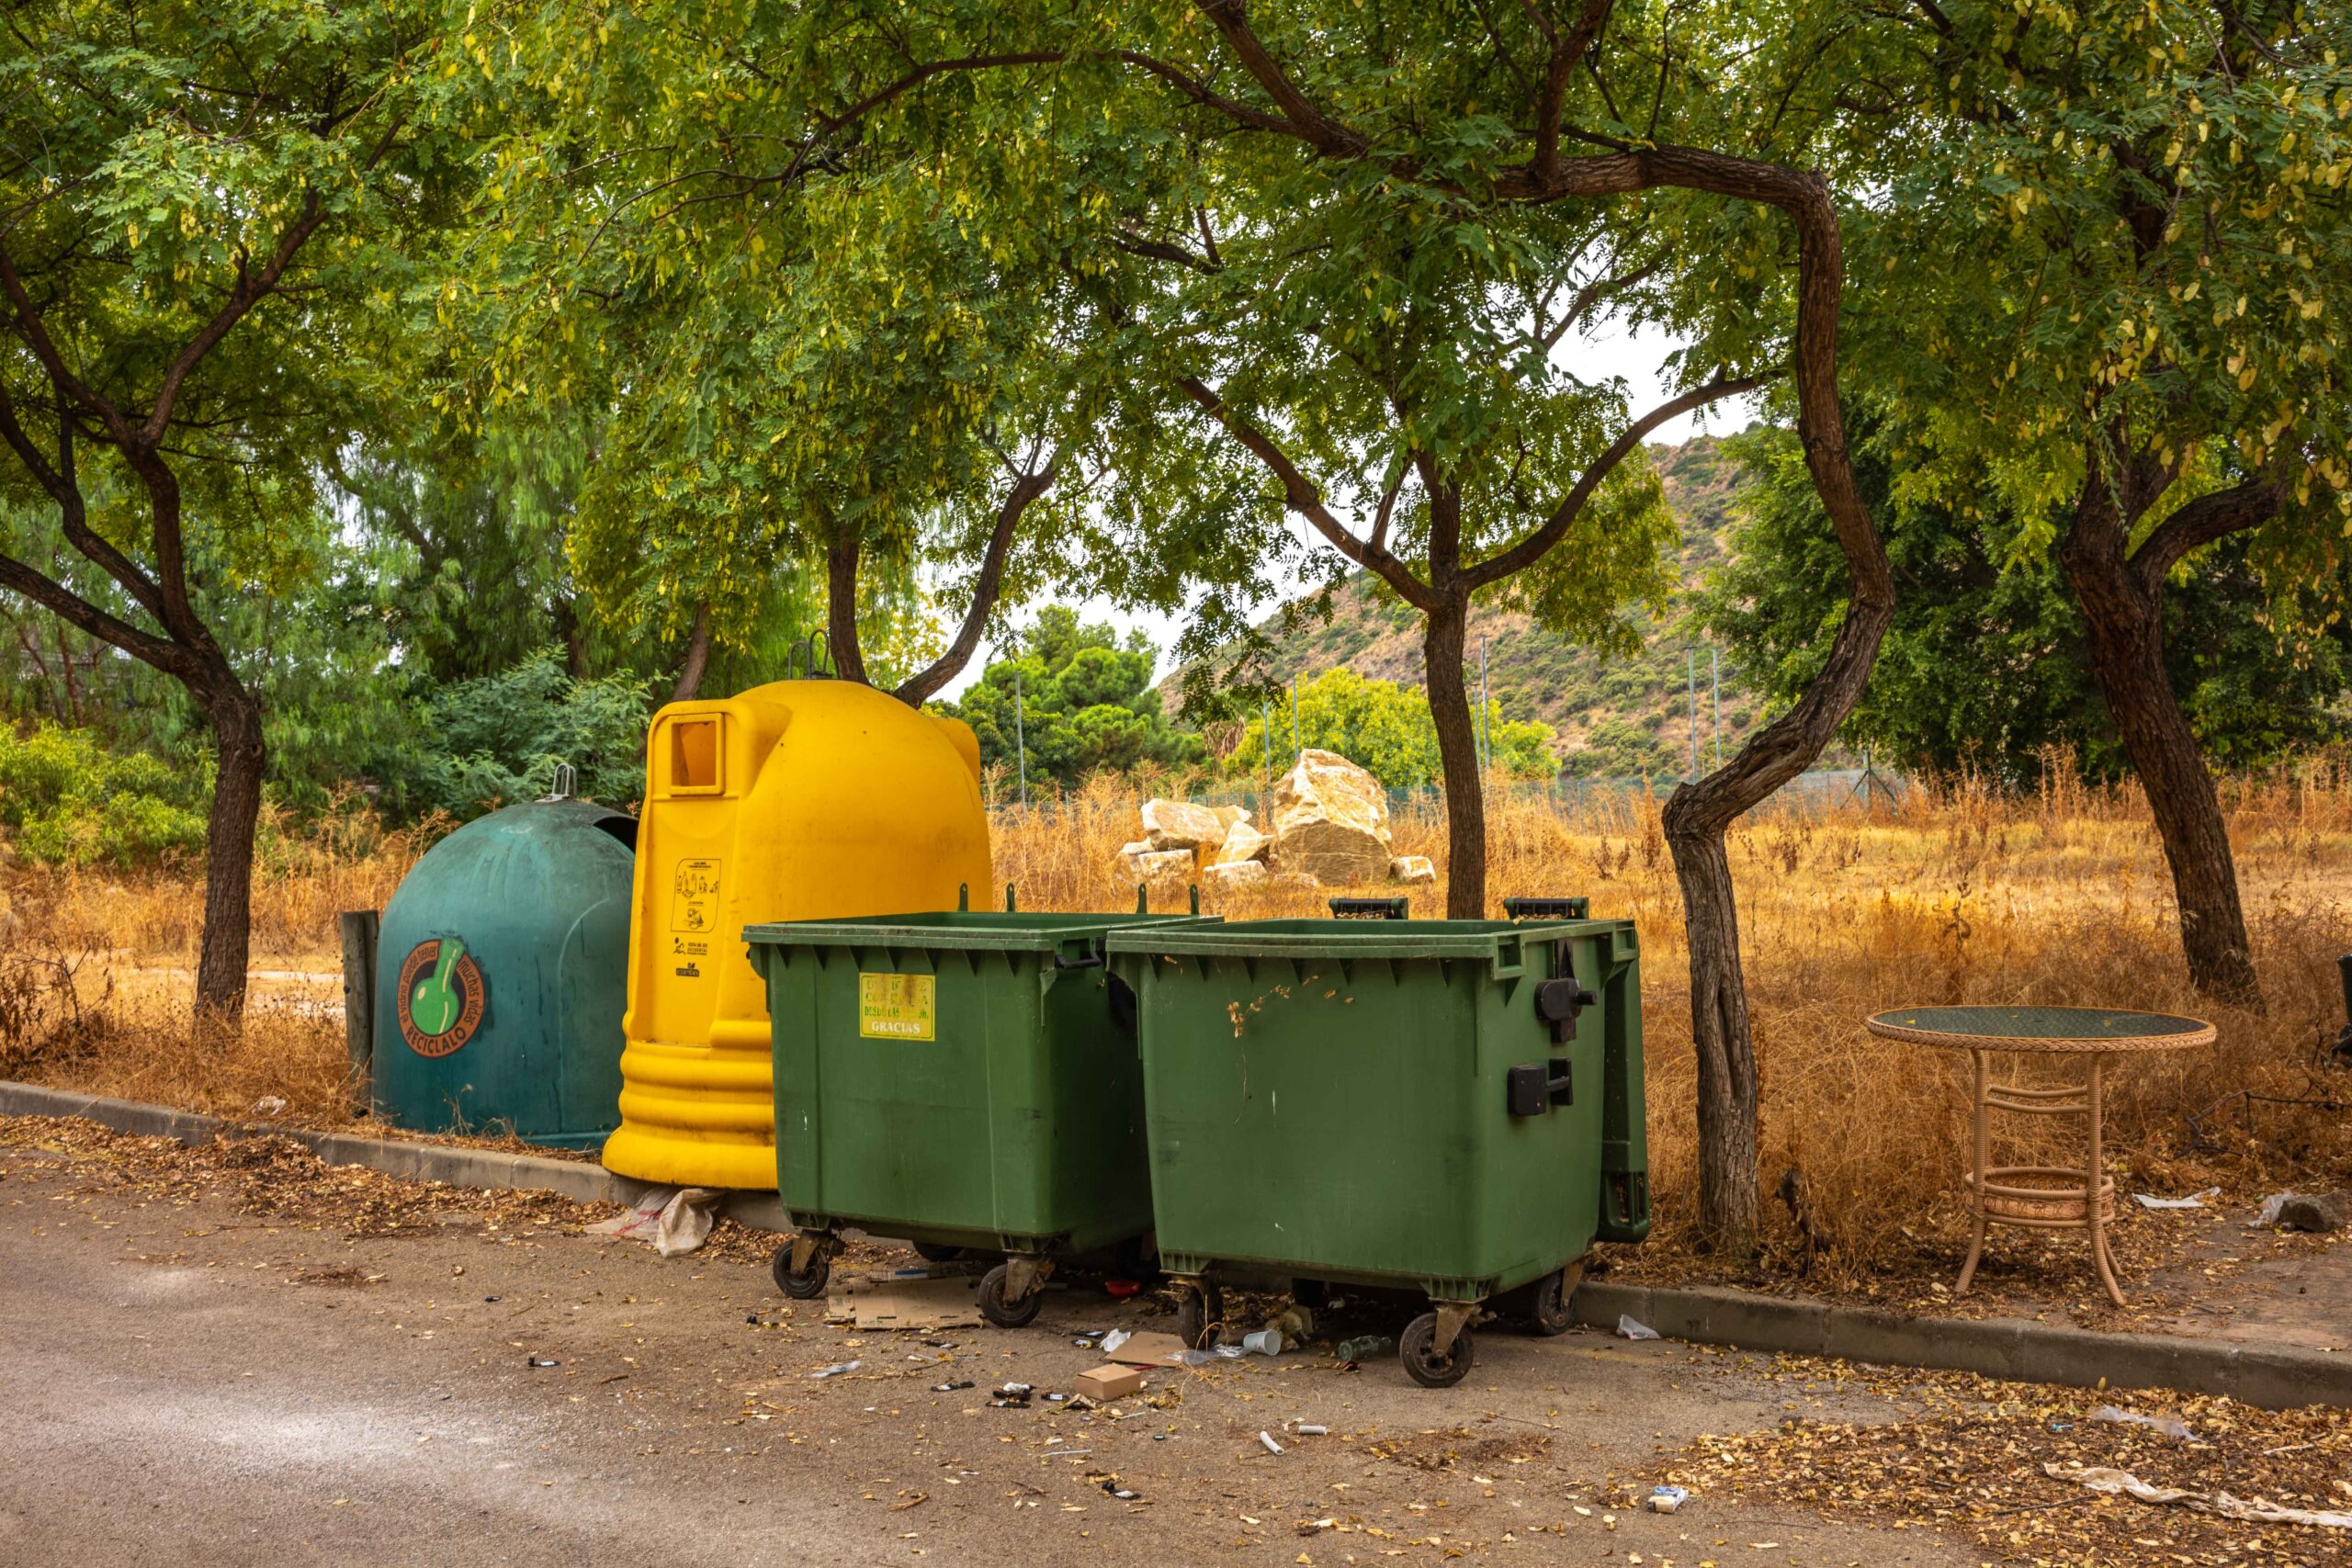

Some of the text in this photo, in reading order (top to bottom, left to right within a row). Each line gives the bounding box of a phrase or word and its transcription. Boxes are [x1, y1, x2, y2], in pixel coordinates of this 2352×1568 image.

[399, 946, 481, 1025] el vidrio puede tener muchas vidas
[406, 1026, 467, 1054] RECICLALO
[871, 1021, 921, 1033] GRACIAS
